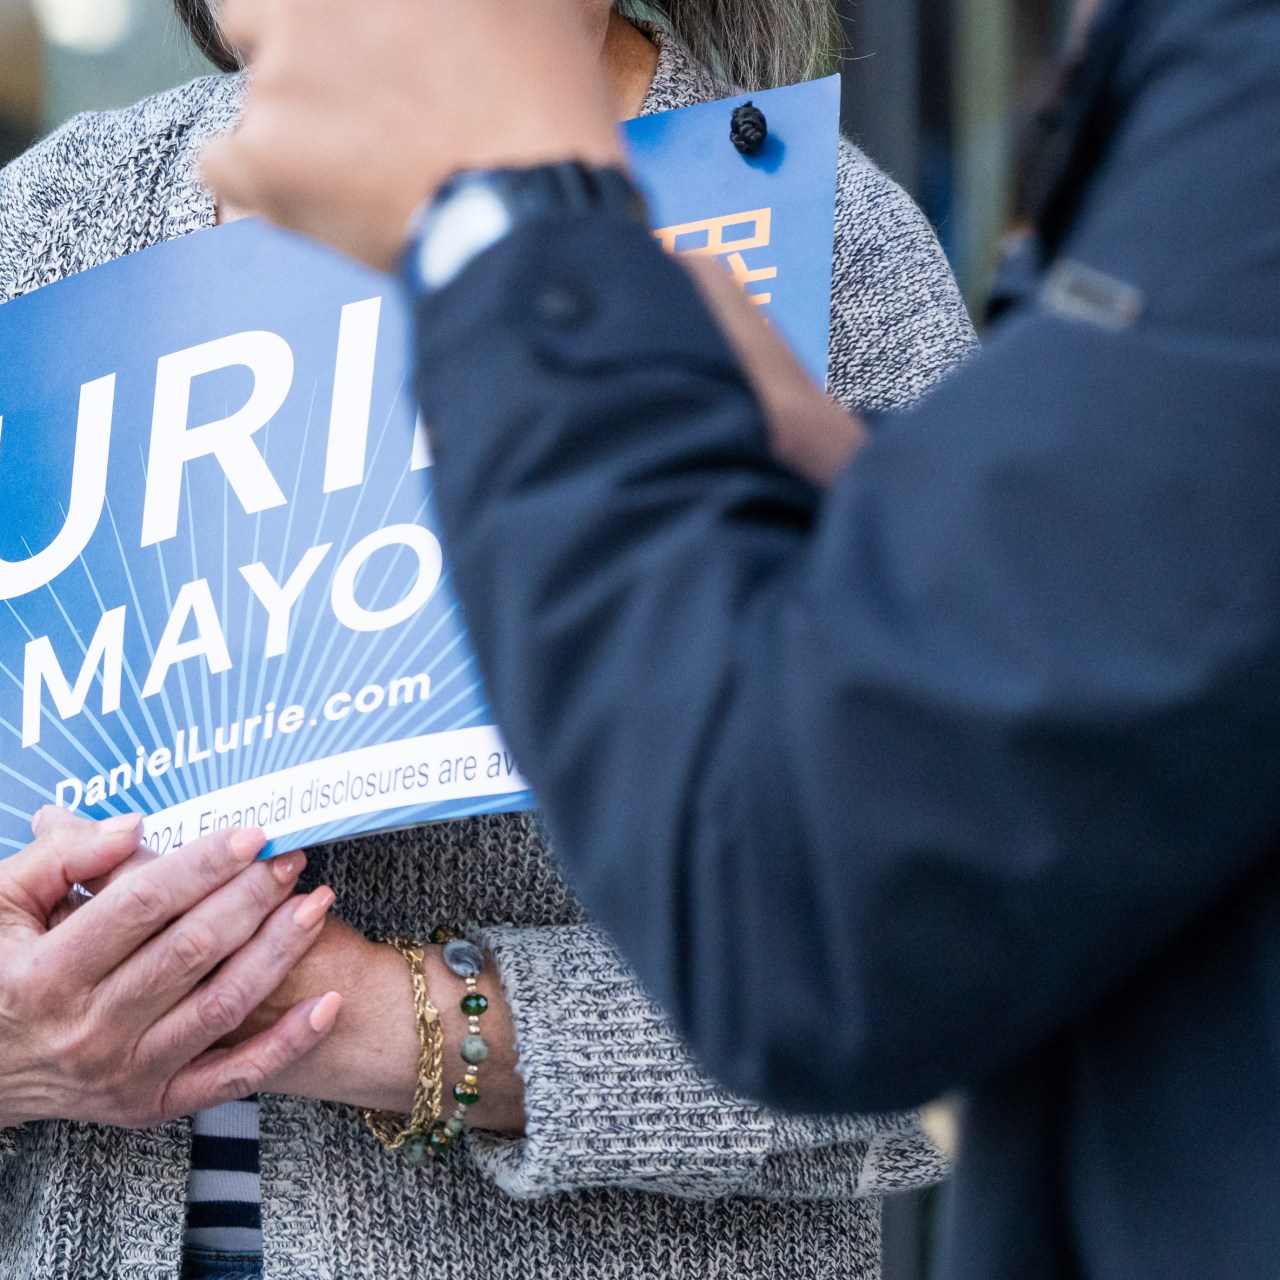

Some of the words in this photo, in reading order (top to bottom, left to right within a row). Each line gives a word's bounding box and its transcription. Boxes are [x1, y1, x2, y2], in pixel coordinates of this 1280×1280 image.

[20, 523, 442, 749] MAYO
[55, 672, 431, 812] DanielLurie.com
[300, 762, 429, 815] disclosures
[438, 755, 477, 785] are
